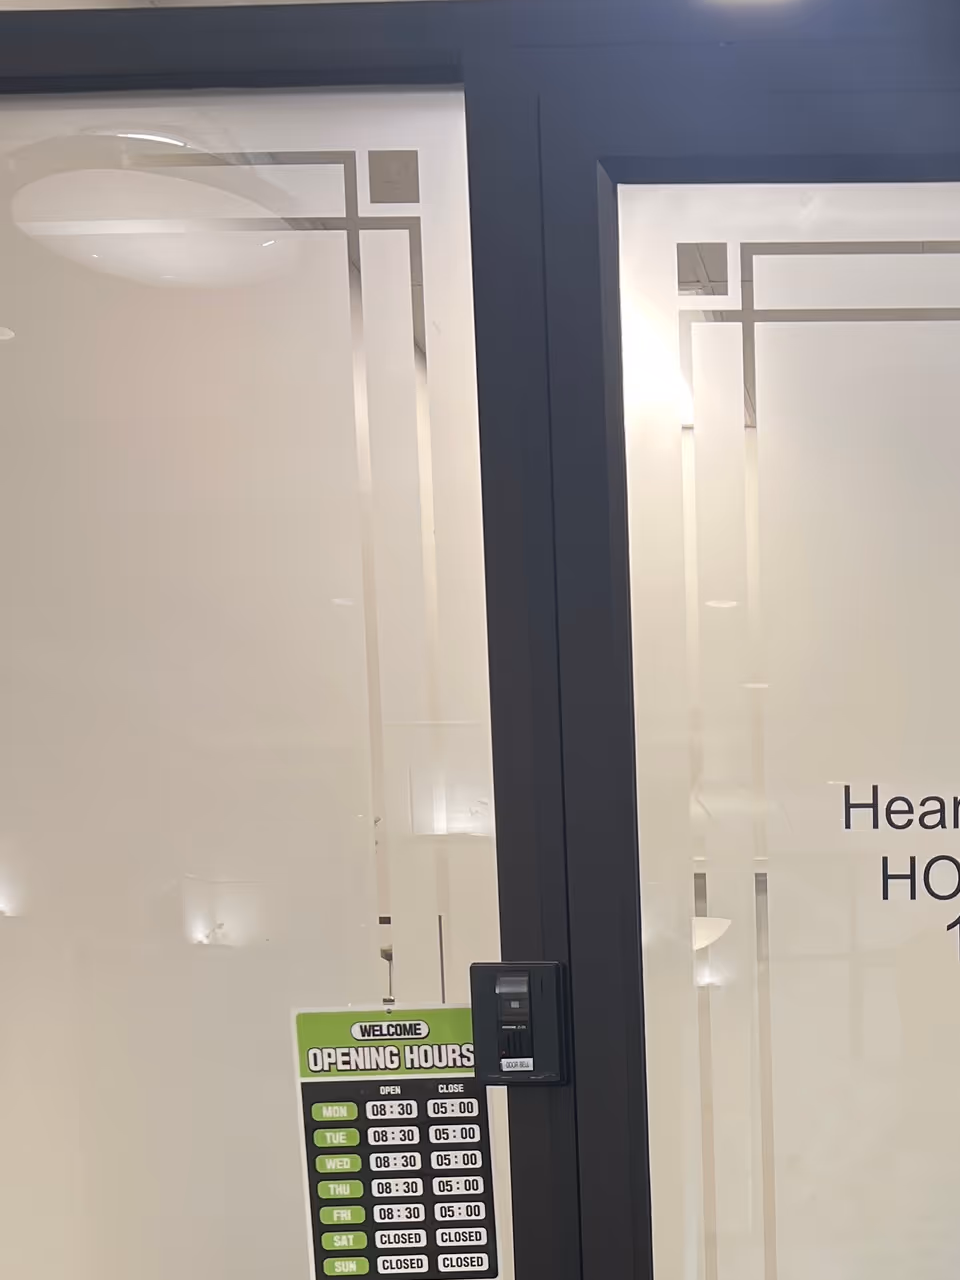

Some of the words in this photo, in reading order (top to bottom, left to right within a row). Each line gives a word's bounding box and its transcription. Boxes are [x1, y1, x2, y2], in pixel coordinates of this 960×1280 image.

[359, 1022, 423, 1038] WELCOME
[307, 1046, 400, 1072] OPENING
[404, 1043, 475, 1069] HOURS
[379, 1085, 402, 1095] OPEN
[438, 1083, 465, 1093] CLOSE
[322, 1105, 348, 1118] MON
[325, 1131, 347, 1144] TUE
[326, 1158, 351, 1170] WED
[328, 1183, 350, 1196] THU
[333, 1209, 352, 1222] FRI
[333, 1234, 354, 1247] SAT
[380, 1232, 422, 1245] CLOSED
[441, 1230, 483, 1243] CLOSED
[334, 1260, 357, 1273] SUN
[382, 1257, 424, 1271] CLOSED
[442, 1256, 484, 1269] CLOSED
